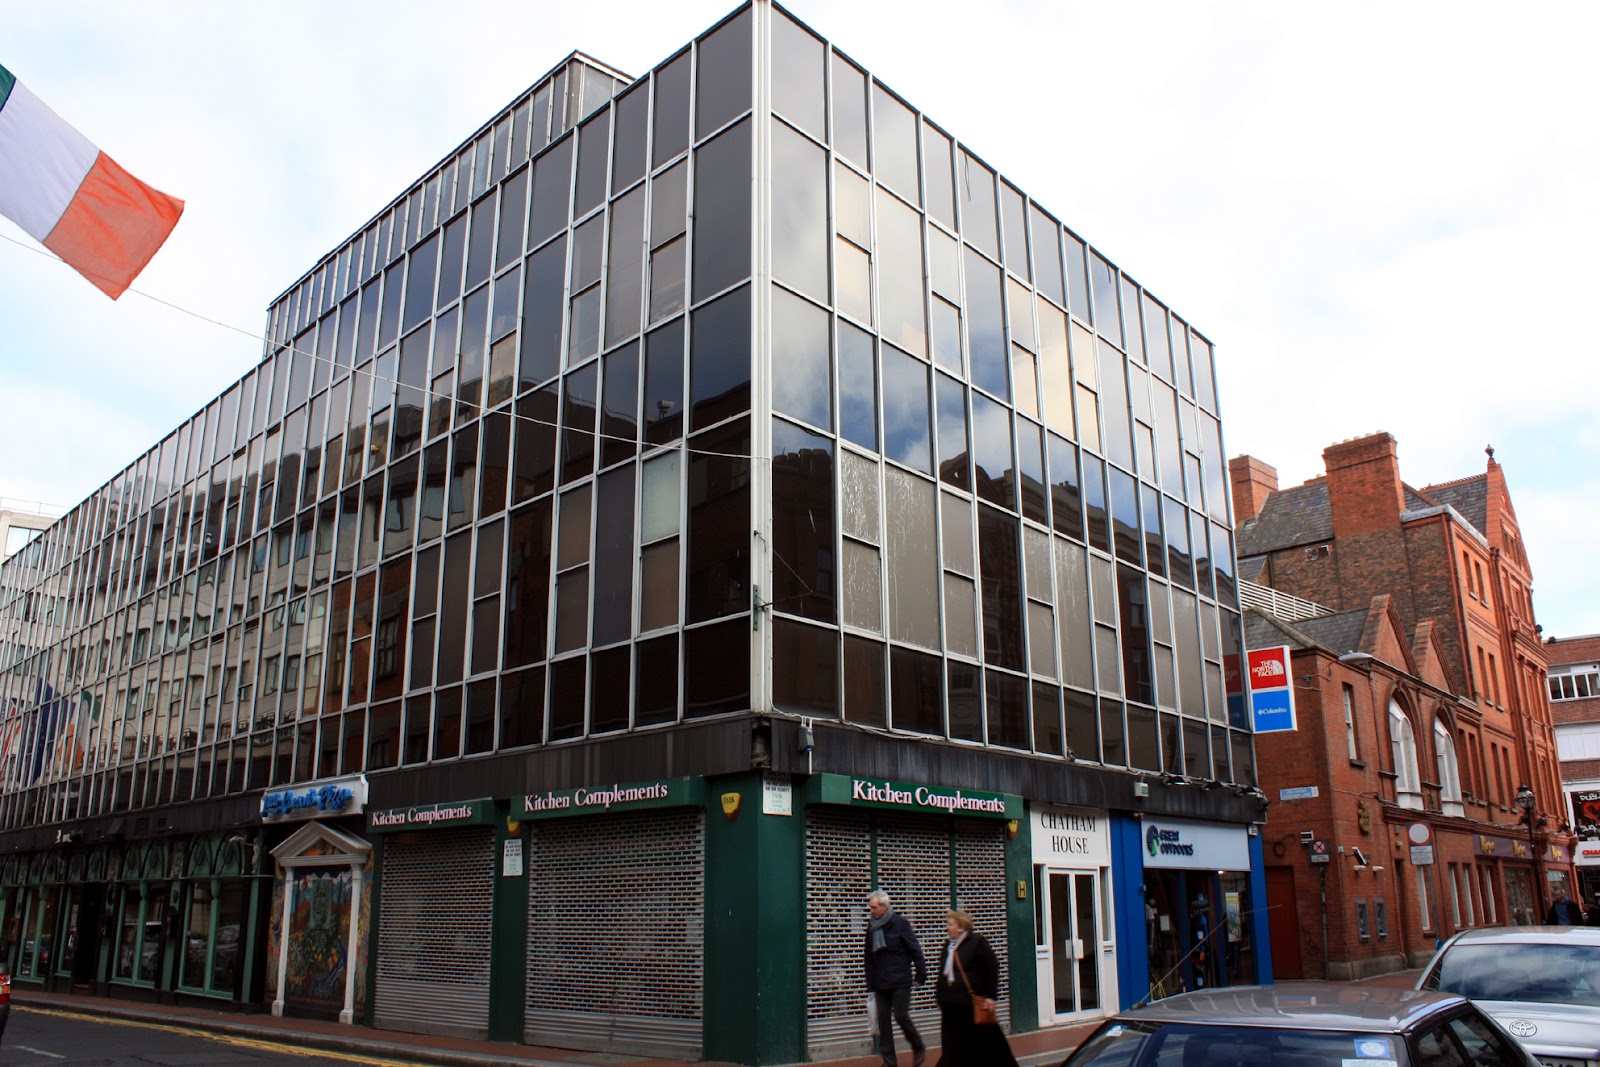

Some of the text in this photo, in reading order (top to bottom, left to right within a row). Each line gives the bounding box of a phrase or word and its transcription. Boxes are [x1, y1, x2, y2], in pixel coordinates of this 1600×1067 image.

[1252, 665, 1273, 673] NORTH
[524, 782, 668, 812] Kitchen Complements
[852, 780, 1005, 813] Kitchen Complements
[371, 804, 472, 826] Kitchen Complements
[1040, 811, 1096, 832] CHATHAM
[1052, 835, 1089, 854] HOUSE
[1160, 829, 1180, 842] GREAT
